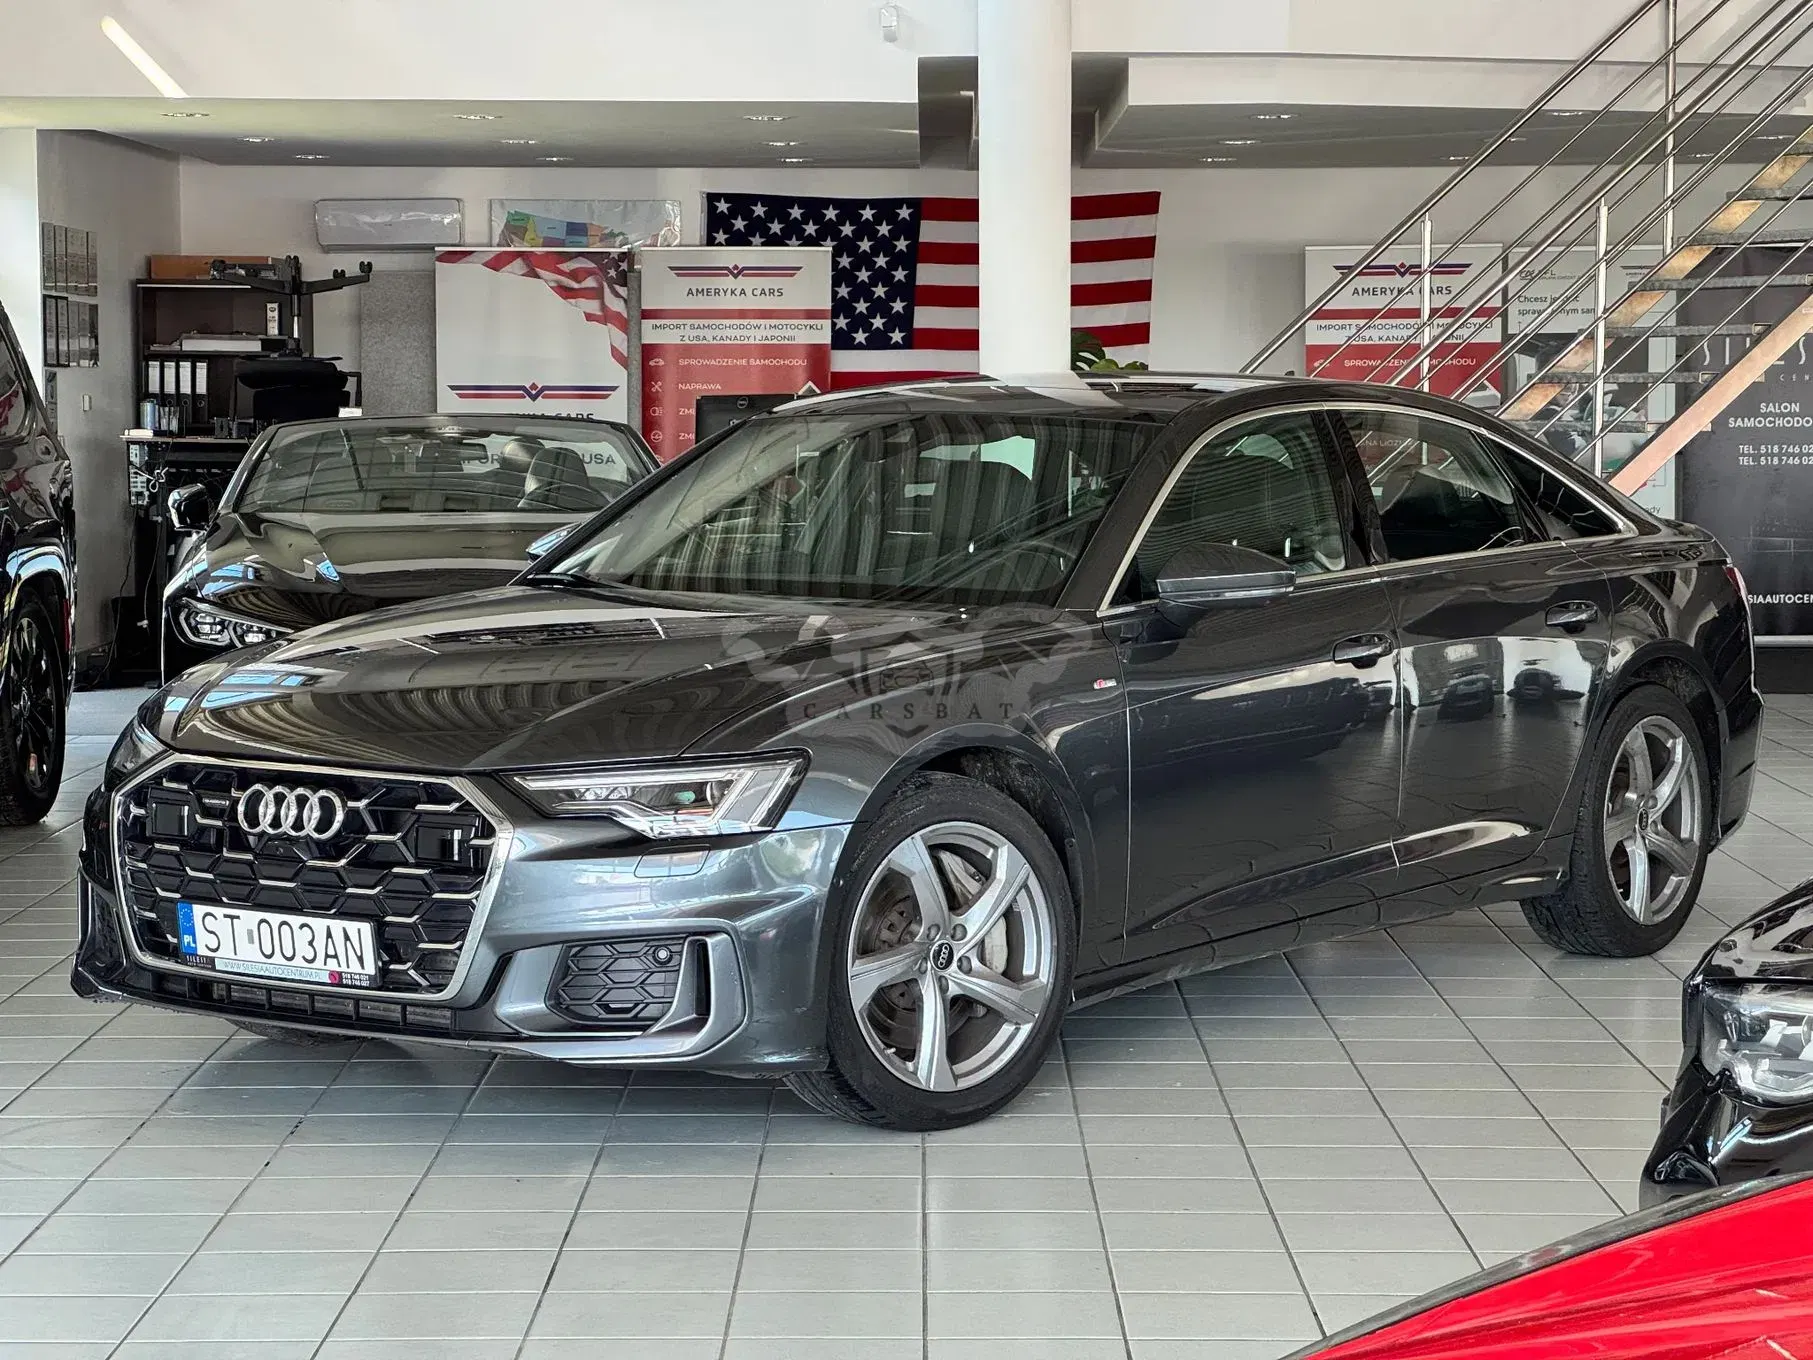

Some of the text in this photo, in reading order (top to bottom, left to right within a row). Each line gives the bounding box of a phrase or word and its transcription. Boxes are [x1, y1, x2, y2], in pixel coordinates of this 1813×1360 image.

[687, 288, 784, 297] AMERYKA CARS
[651, 323, 687, 331] IMPORT
[689, 321, 762, 331] SAMOCHODÓW
[769, 323, 823, 331] MOTOCYKLI
[1316, 323, 1352, 331] IMPORT
[678, 358, 808, 366] SPROWADZENIE SAMOCHODU
[1760, 402, 1800, 413] SALON
[1728, 416, 1813, 428] SAMOCHODO
[678, 432, 695, 440] ZMI
[1739, 445, 1758, 454] TEL.
[1760, 444, 1779, 454] 518
[1781, 444, 1800, 454] 746
[582, 453, 616, 465] USA
[1739, 456, 1758, 465] TEL.
[1760, 456, 1779, 465] 518
[1781, 456, 1800, 465] 746
[183, 934, 196, 948] PL
[201, 911, 366, 971] ST 003AN
